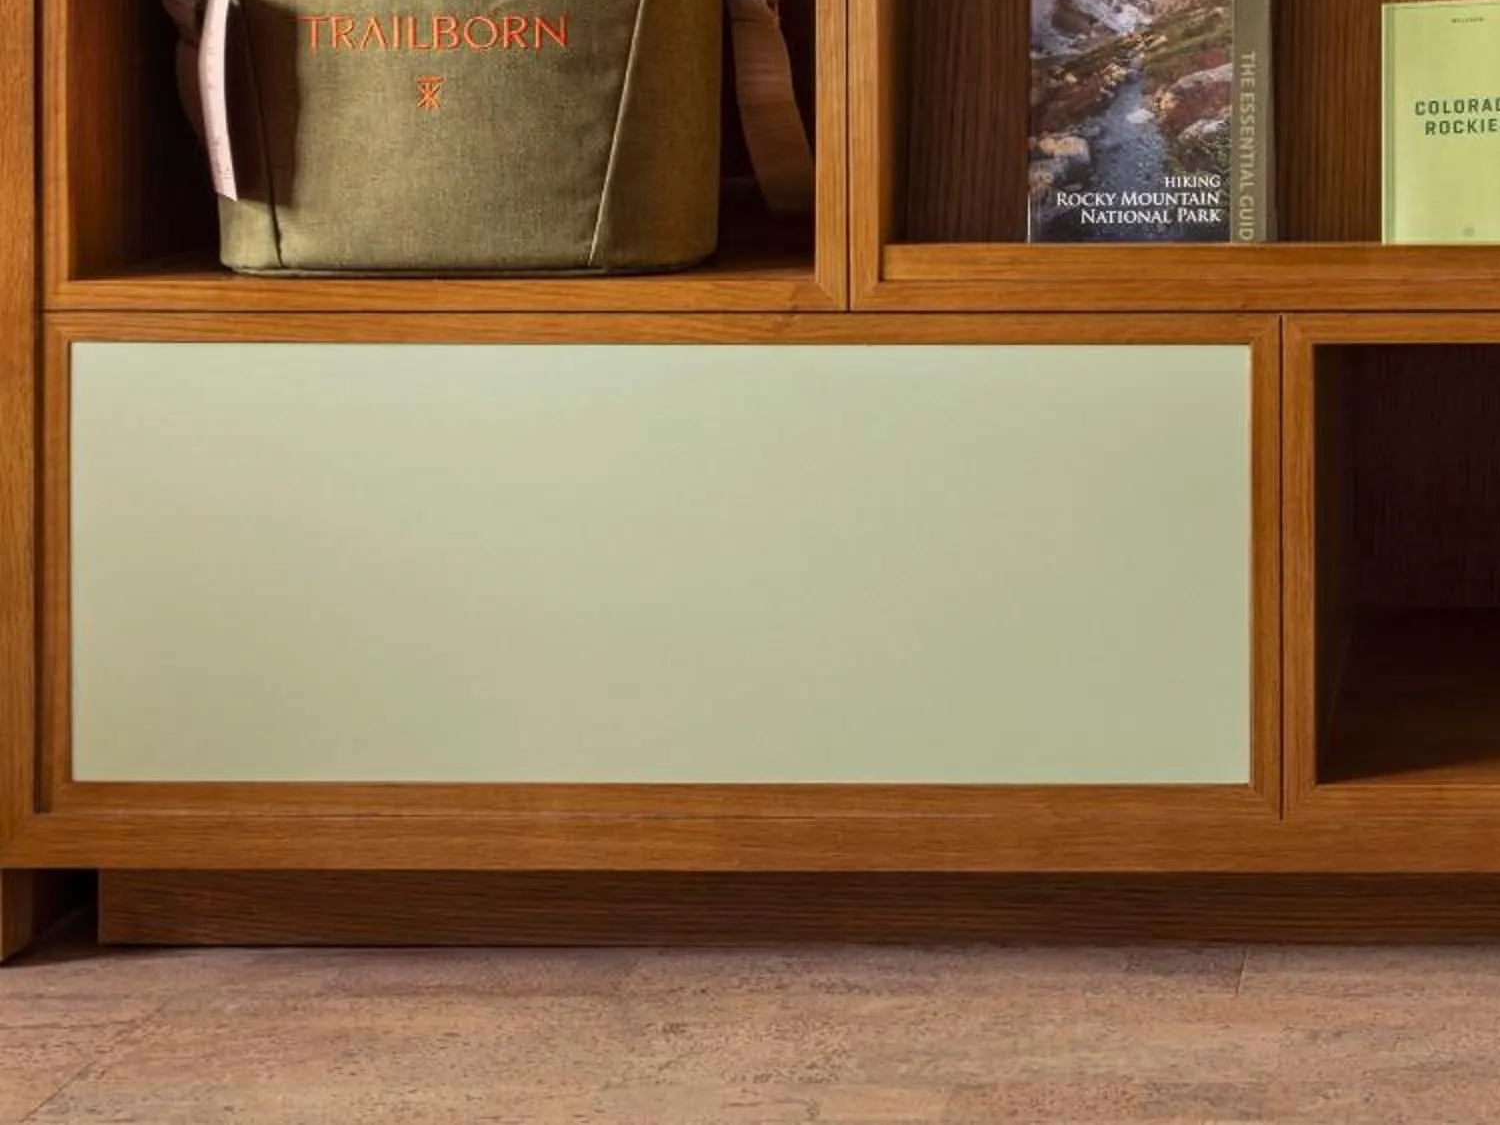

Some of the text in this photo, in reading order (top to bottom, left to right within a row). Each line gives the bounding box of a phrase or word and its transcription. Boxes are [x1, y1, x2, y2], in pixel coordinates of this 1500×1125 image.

[301, 13, 572, 53] TRAILBORN
[1238, 51, 1256, 241] THE ESSENTIAL GUID
[1164, 175, 1222, 189] HIKING
